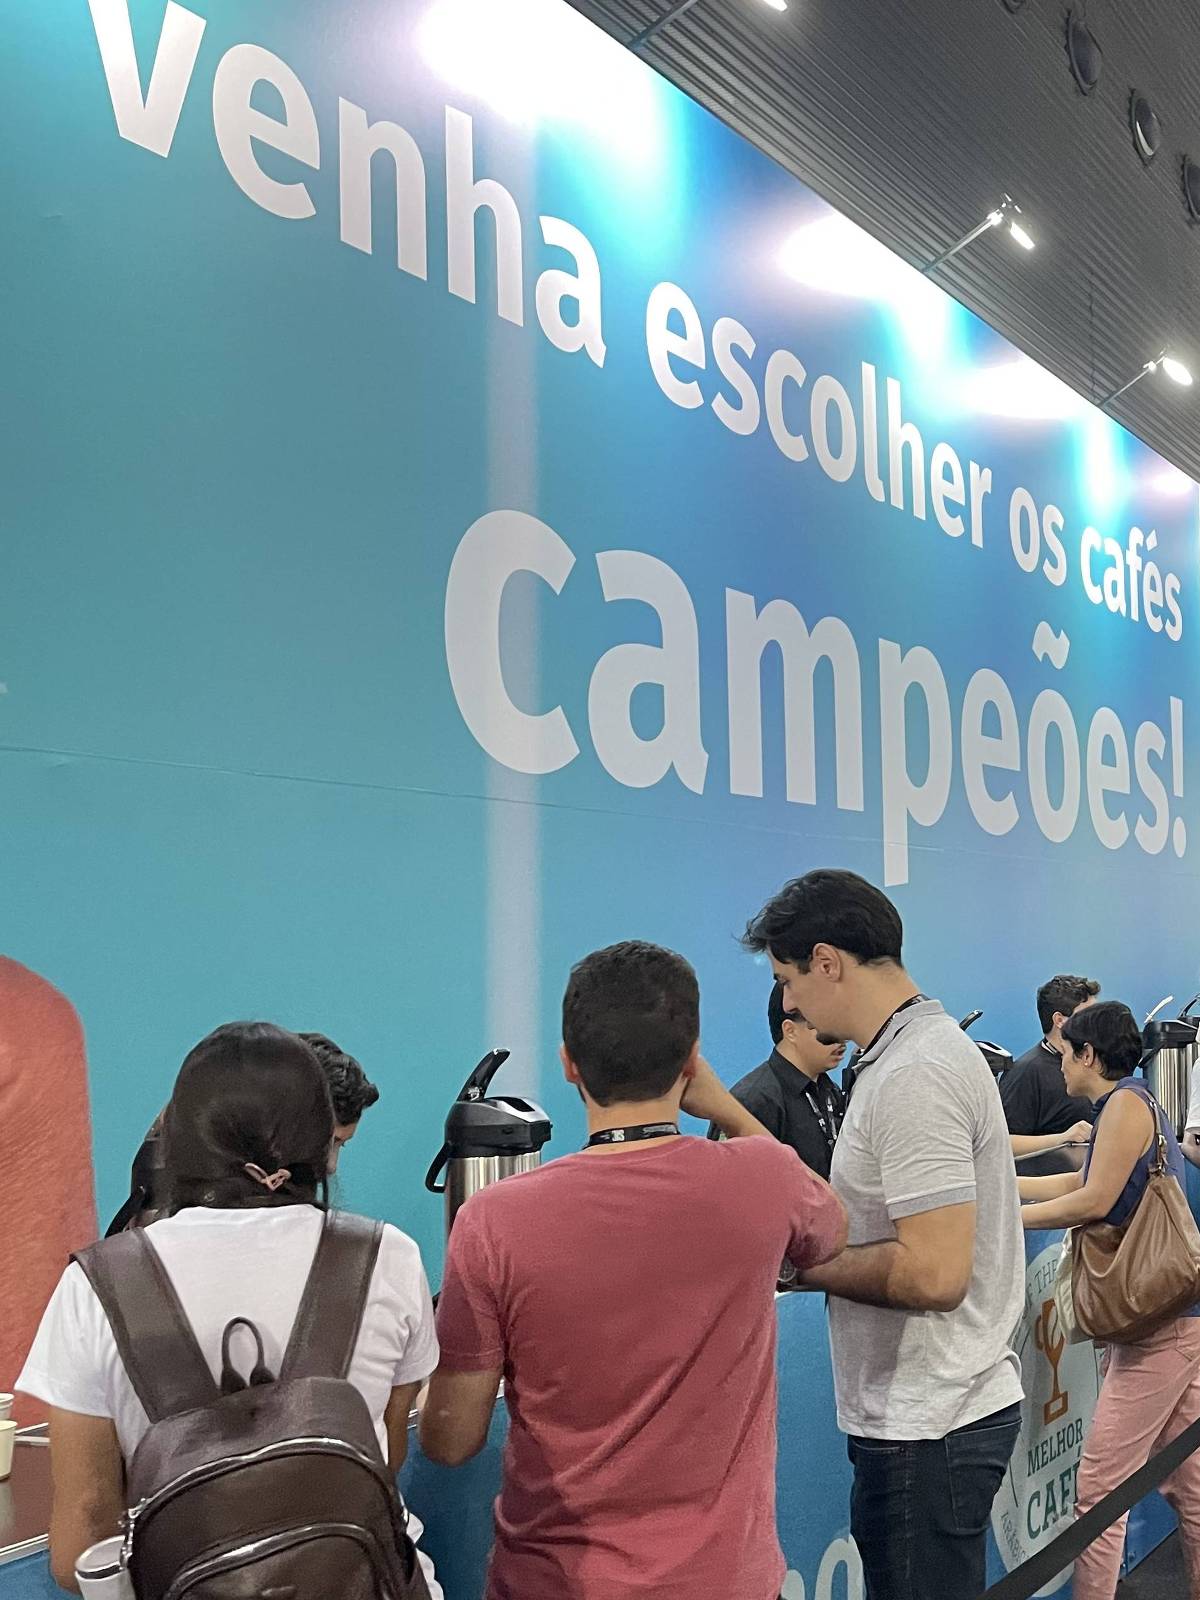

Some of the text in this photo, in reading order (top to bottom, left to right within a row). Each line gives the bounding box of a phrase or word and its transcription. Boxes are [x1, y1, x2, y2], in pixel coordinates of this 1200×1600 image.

[645, 281, 992, 549] escolher
[1009, 487, 1068, 586] os
[1080, 526, 1182, 642] cafés
[444, 509, 1187, 887] campeões!
[1027, 1418, 1084, 1477] MELHOR
